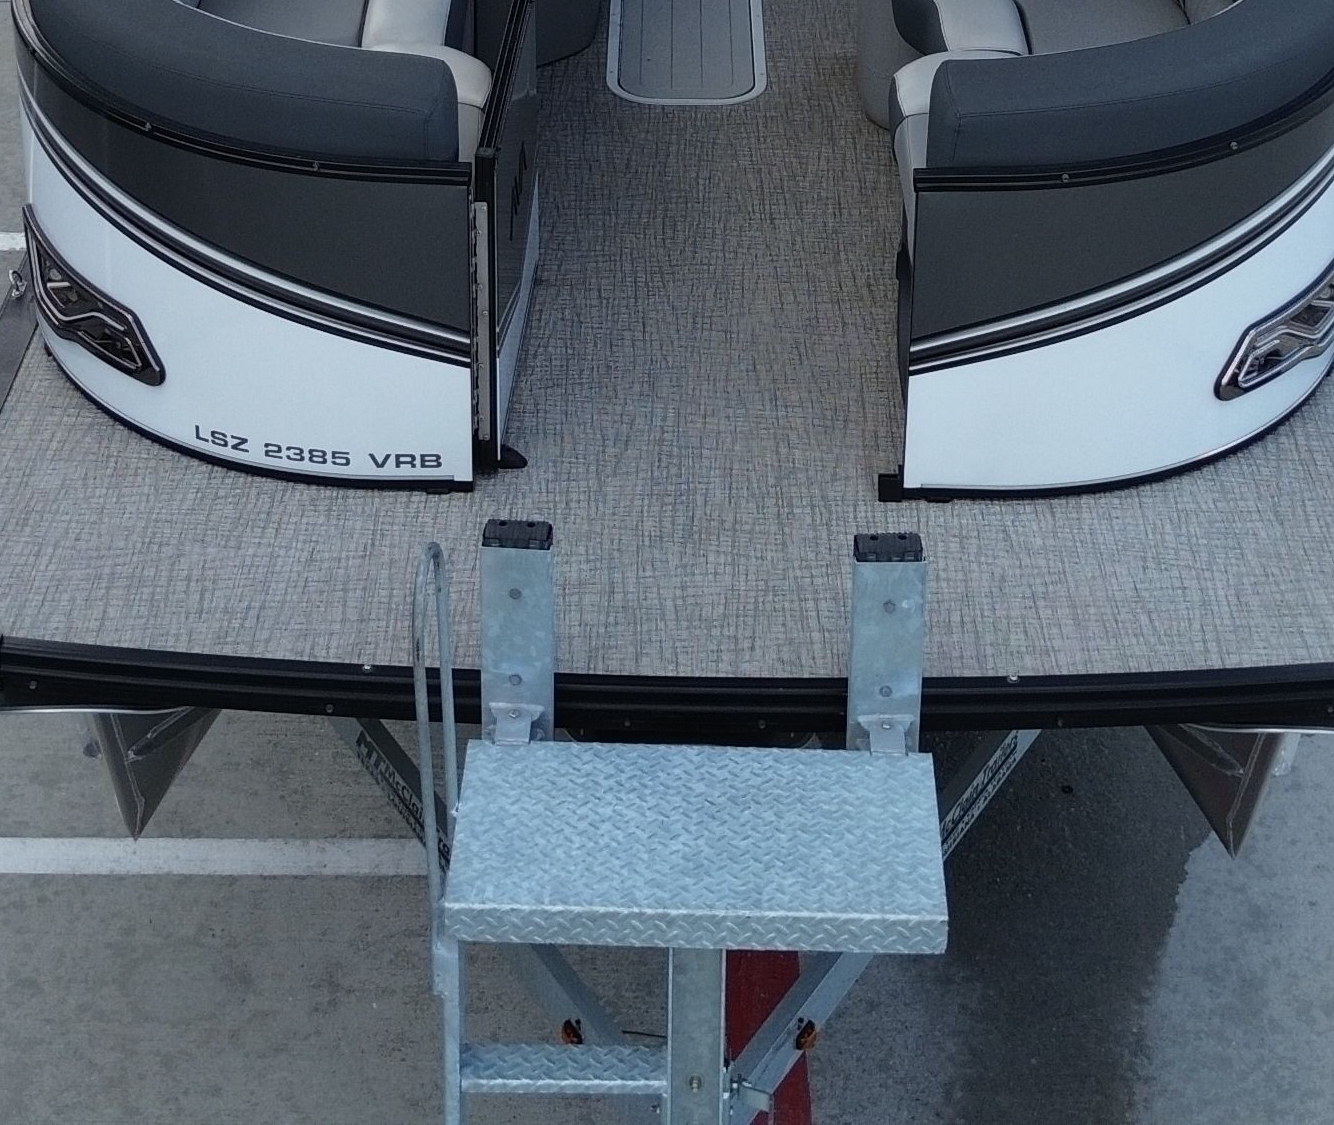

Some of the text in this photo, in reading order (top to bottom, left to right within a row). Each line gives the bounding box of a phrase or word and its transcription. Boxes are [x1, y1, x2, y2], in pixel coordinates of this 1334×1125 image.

[195, 424, 443, 469] LSZ 2385 VRB
[380, 763, 425, 821] McClai
